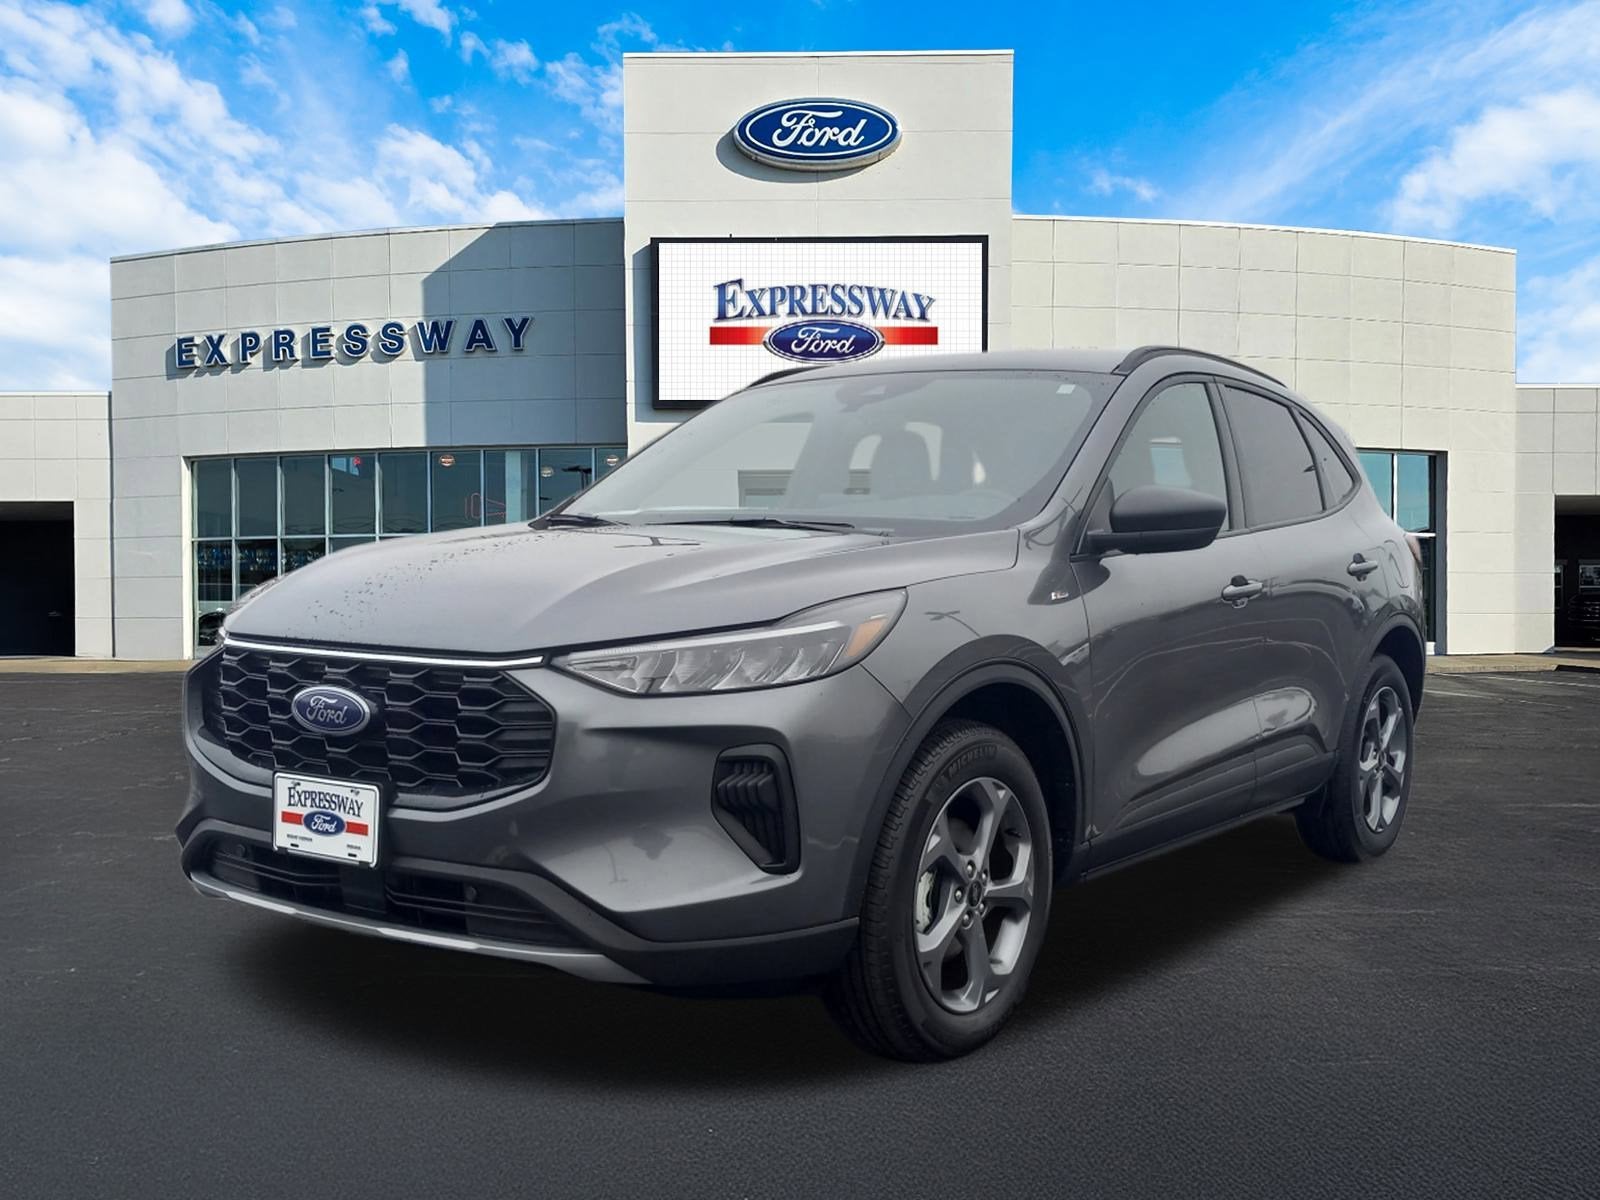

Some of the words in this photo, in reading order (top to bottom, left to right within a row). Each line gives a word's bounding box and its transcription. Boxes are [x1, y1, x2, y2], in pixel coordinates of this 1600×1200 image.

[772, 109, 868, 147] Ford
[174, 315, 534, 369] EXPRESSWAY
[791, 326, 854, 354] Ford
[306, 695, 348, 724] Ford
[949, 743, 998, 778] MICHELIN
[311, 814, 337, 832] Ford
